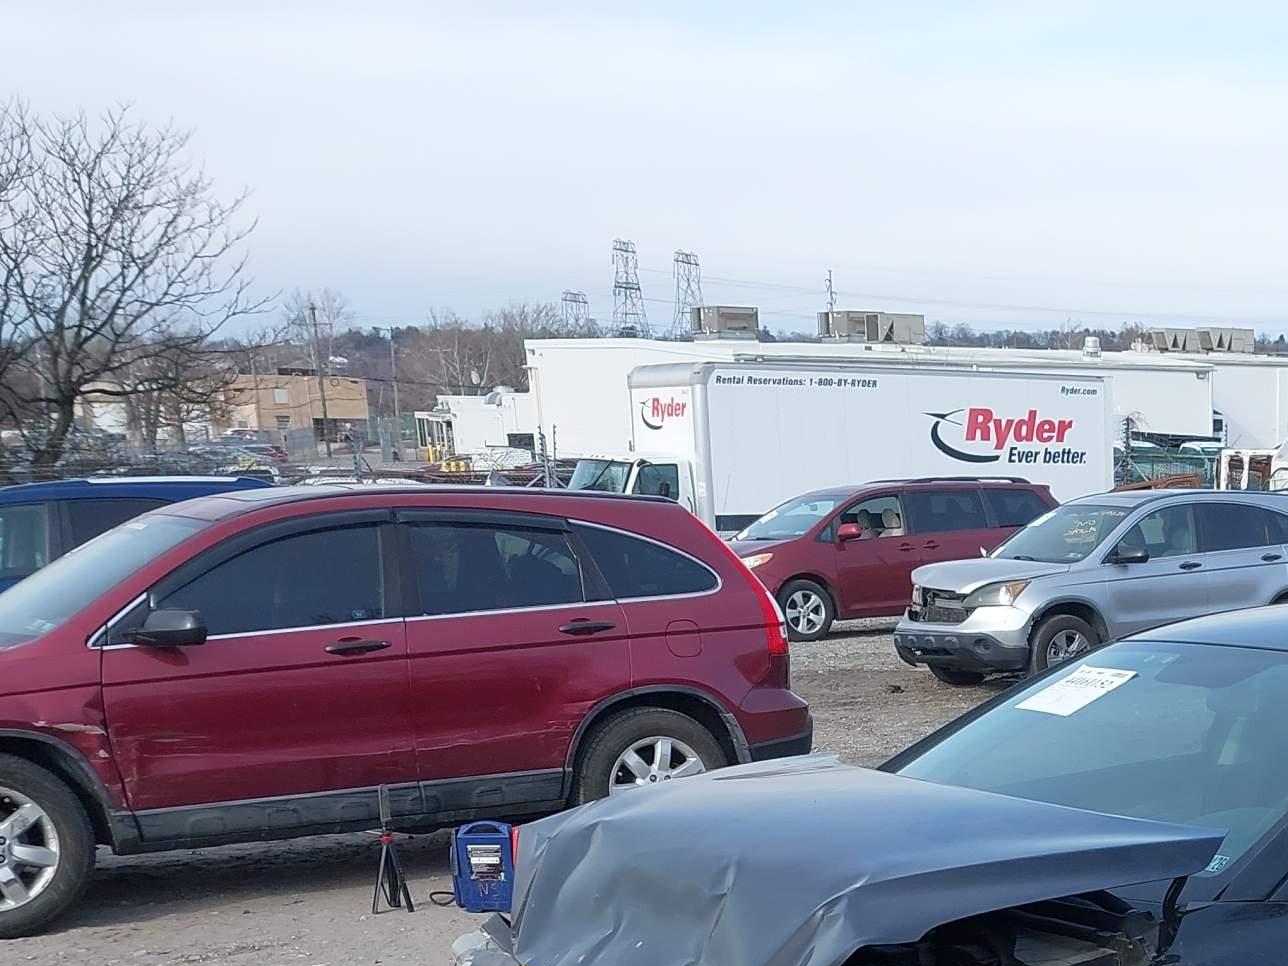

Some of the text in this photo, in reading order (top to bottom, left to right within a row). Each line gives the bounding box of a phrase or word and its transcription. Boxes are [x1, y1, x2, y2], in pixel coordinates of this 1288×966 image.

[715, 375, 878, 388] Rental Reservations: 1-800-BY-RYDER
[1060, 386, 1097, 396] Ryder.com
[652, 397, 687, 422] Ryder
[965, 408, 1073, 450] Ryder
[1007, 446, 1087, 464] Ever better.
